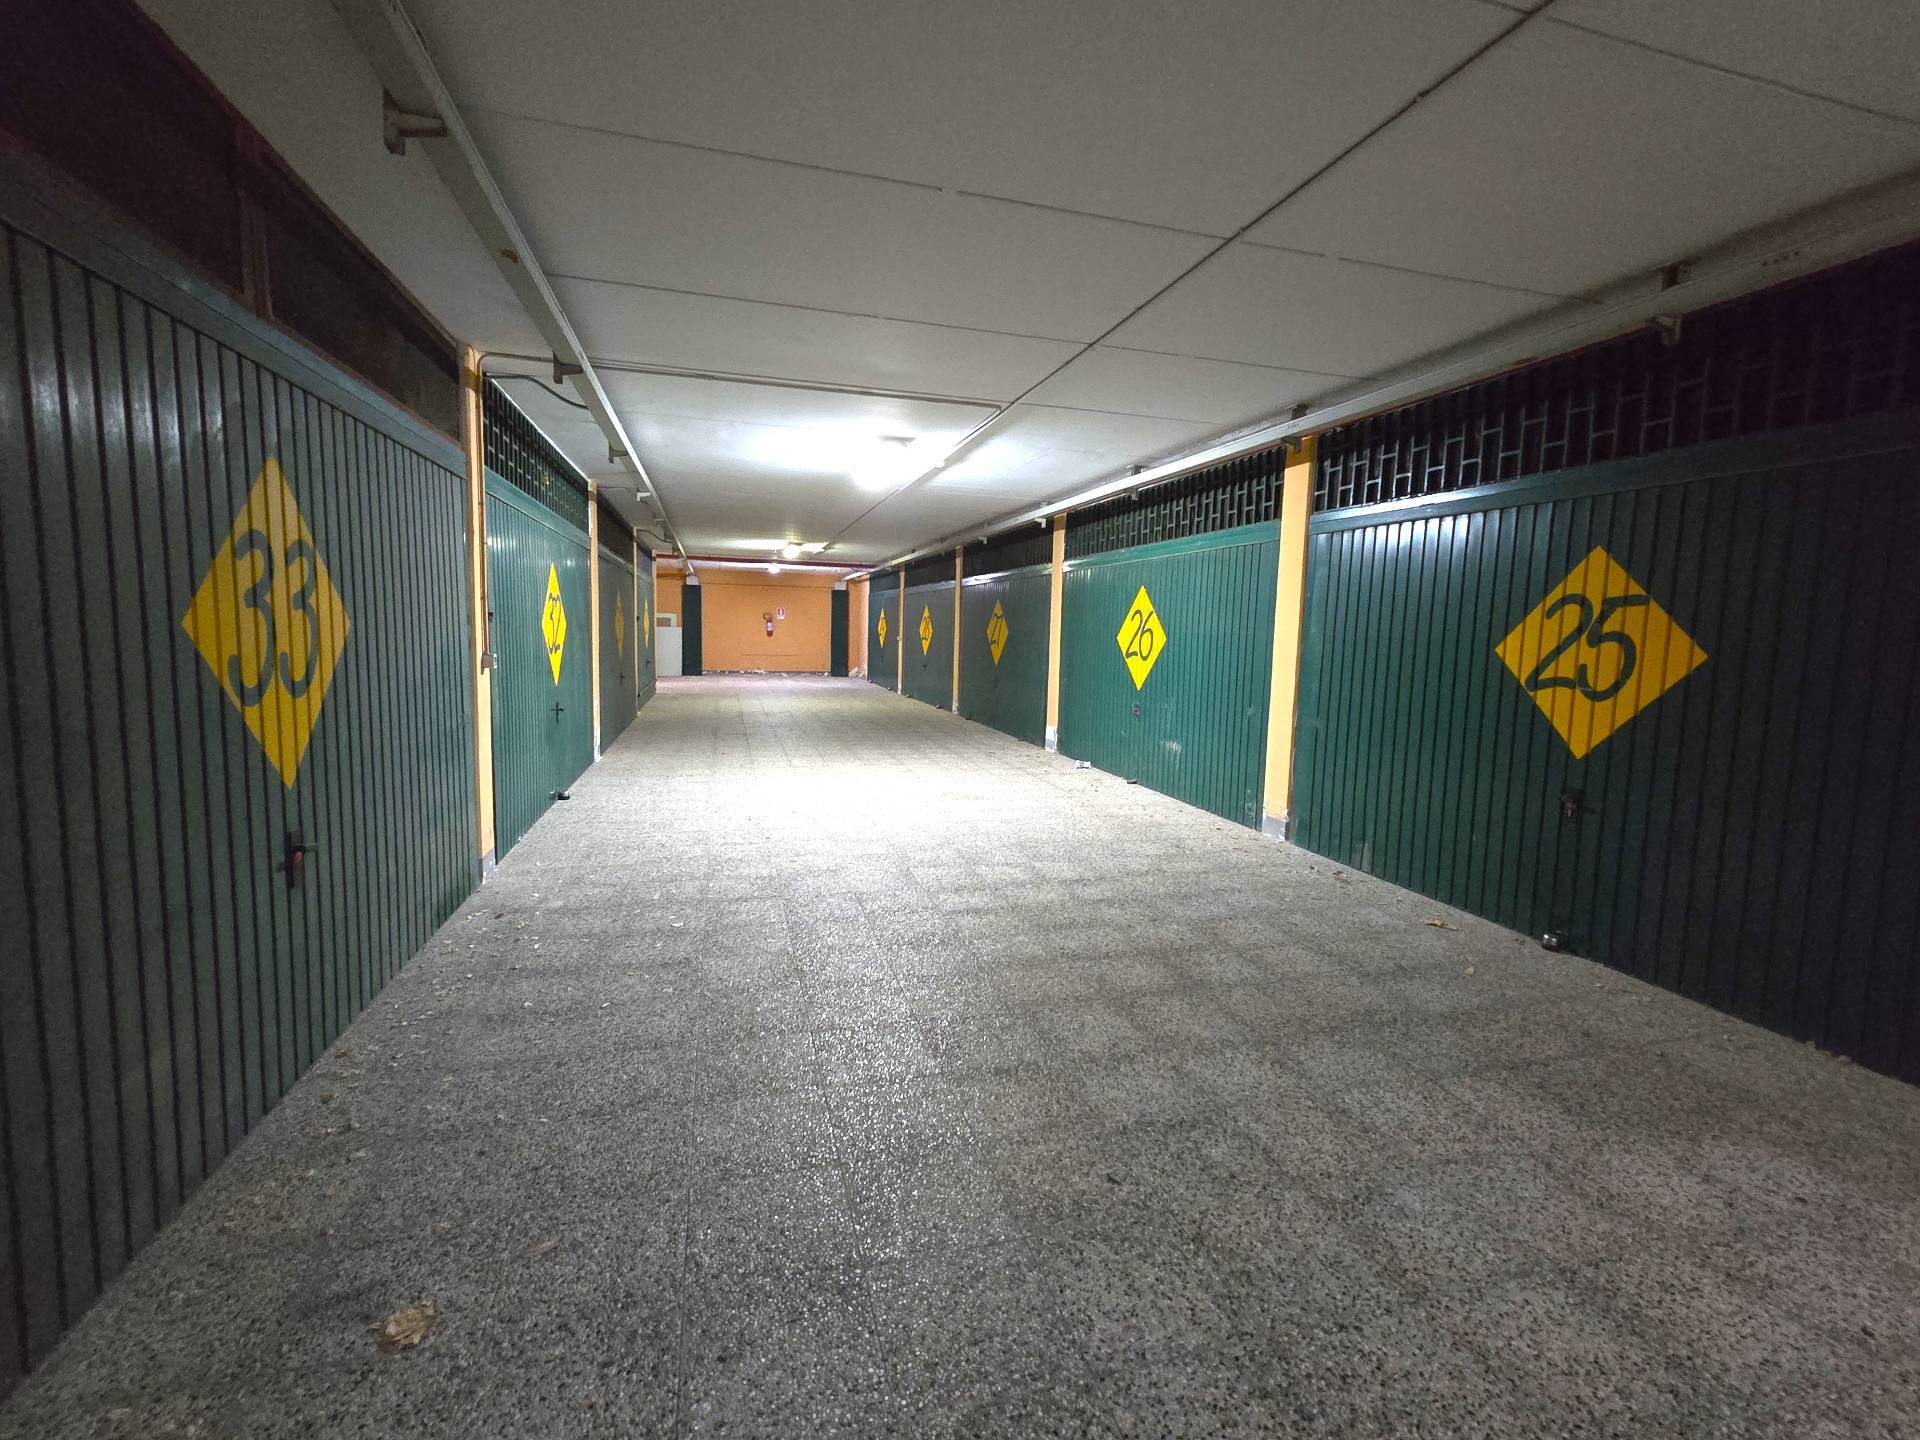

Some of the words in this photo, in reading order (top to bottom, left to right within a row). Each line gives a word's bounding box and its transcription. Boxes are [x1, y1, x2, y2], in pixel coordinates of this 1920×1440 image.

[228, 529, 317, 708] 33
[1125, 609, 1155, 661] 26
[1524, 593, 1652, 703] 25
